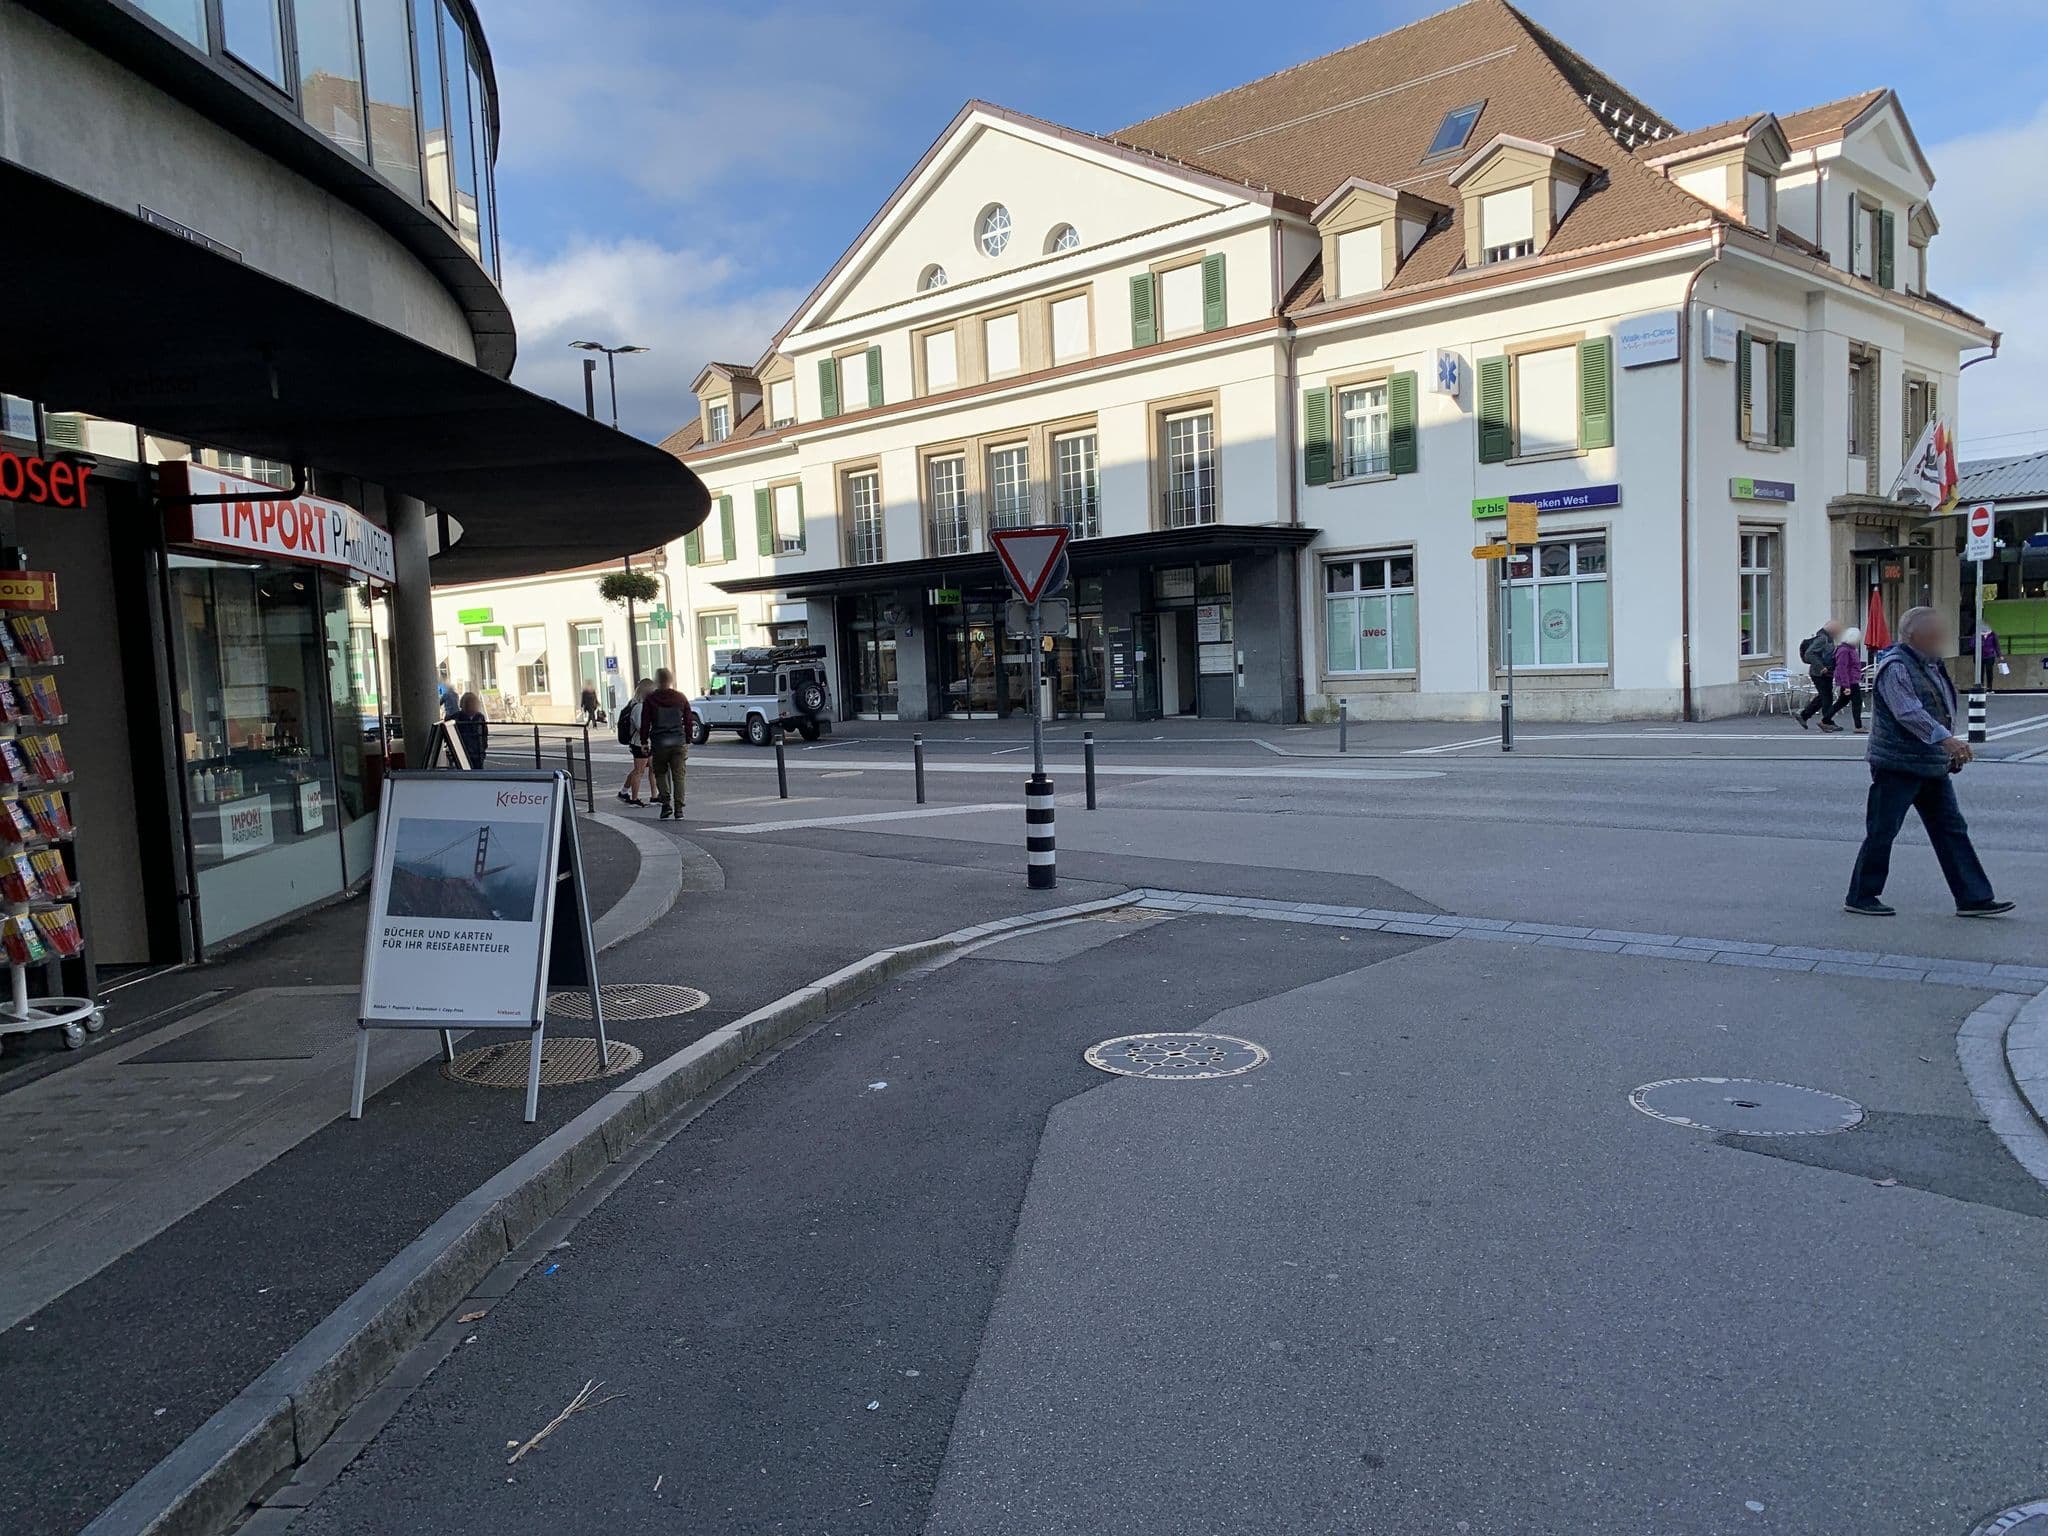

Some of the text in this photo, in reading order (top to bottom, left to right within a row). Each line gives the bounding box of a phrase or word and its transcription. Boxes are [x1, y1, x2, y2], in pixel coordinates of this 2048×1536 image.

[1621, 328, 1675, 343] Walk-in-Clinic
[1488, 503, 1505, 513] bls
[1563, 495, 1588, 506] West
[219, 481, 326, 554] IMPORT
[1362, 628, 1387, 638] avec
[496, 790, 549, 808] Krebser
[231, 807, 261, 831] IMPORT
[384, 926, 493, 941] BÜCHER UND KARTEN
[382, 938, 510, 953] FÜR IHR REISEABENTEUER
